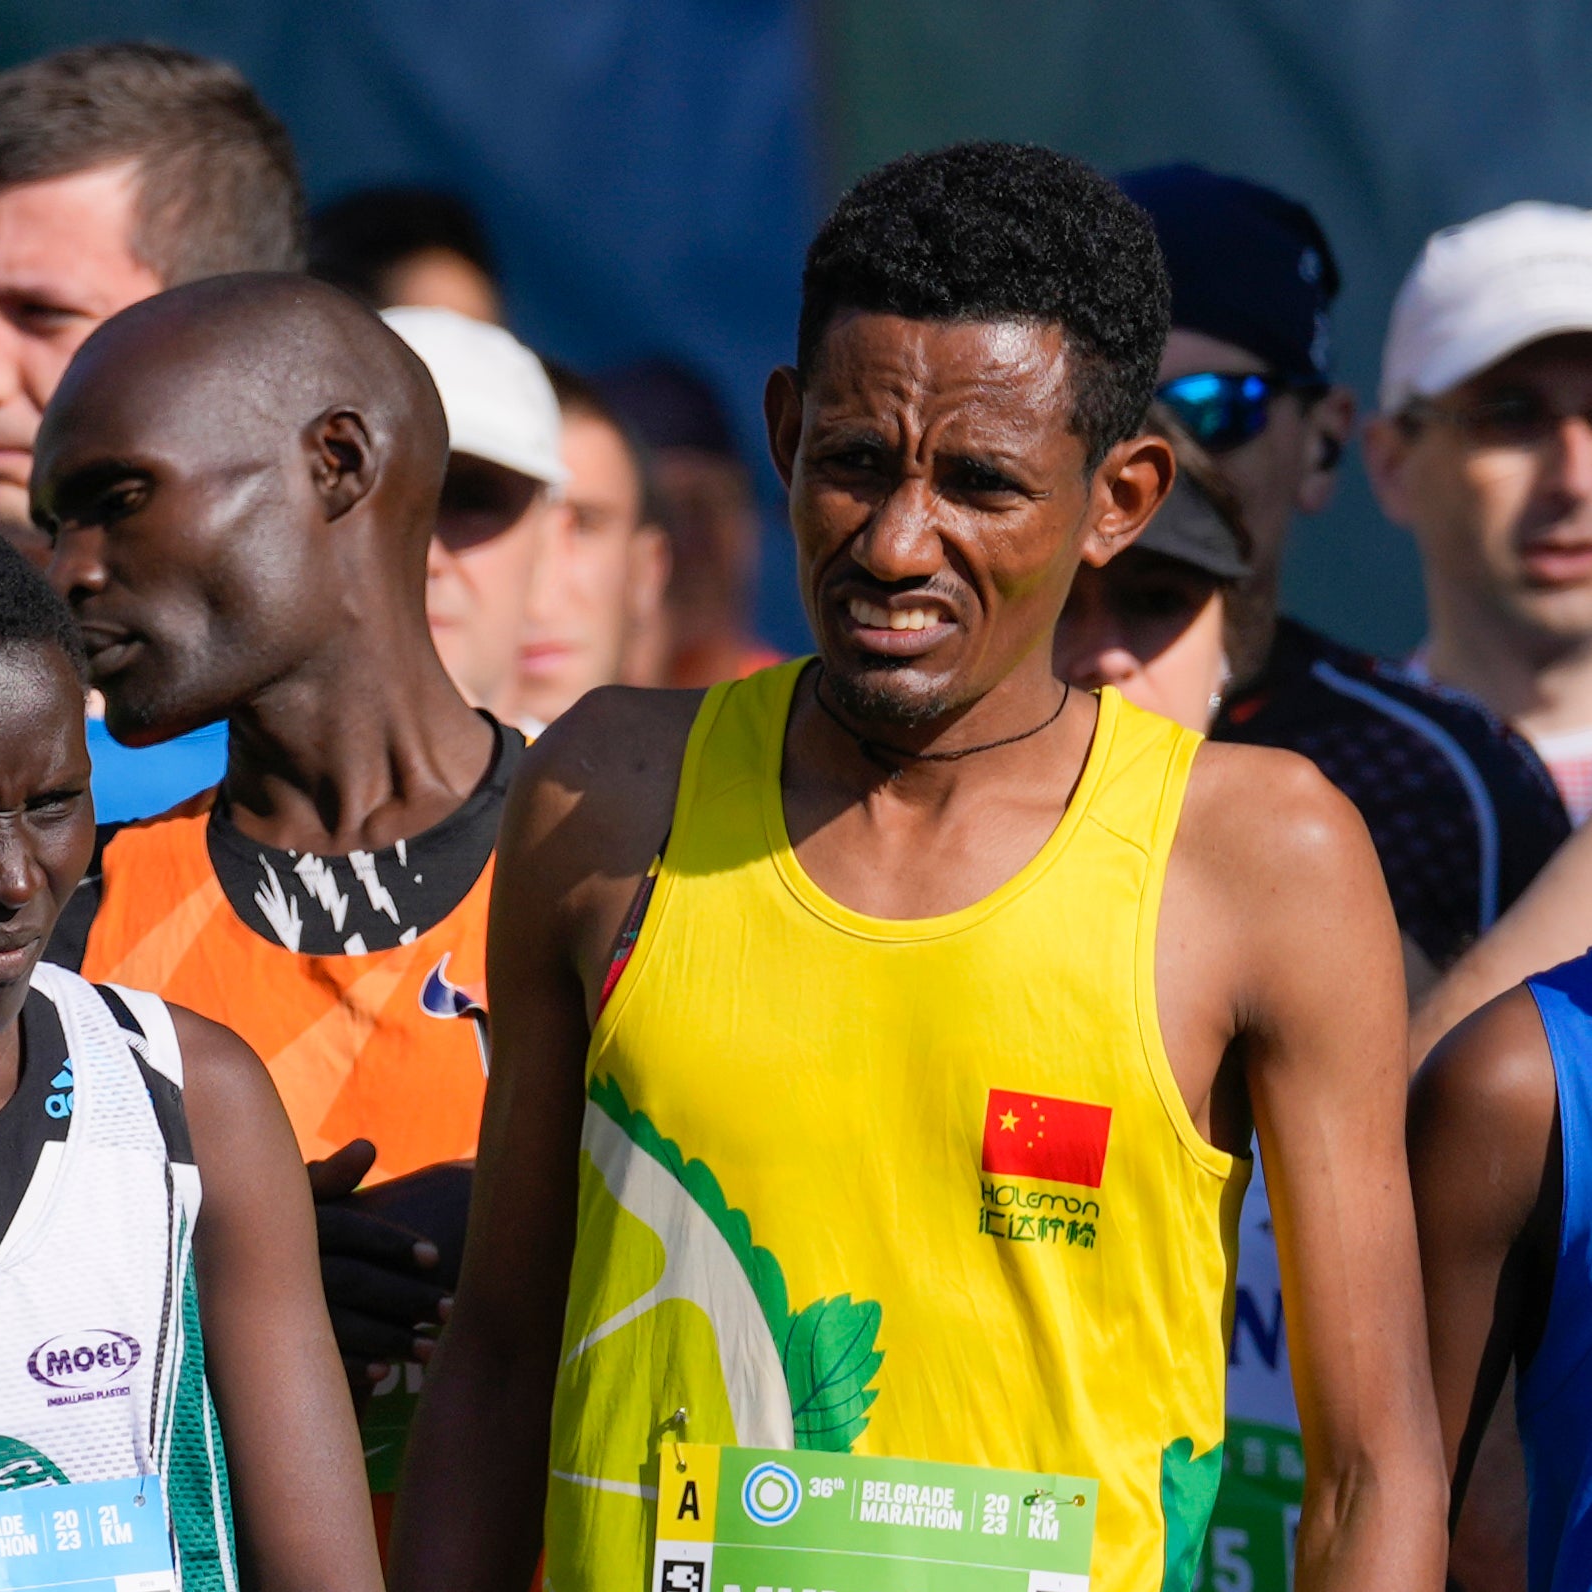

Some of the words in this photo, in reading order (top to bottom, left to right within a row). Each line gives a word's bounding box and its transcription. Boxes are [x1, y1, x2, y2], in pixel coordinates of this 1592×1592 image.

[46, 1341, 127, 1377] MOEL
[676, 1480, 700, 1521] A
[808, 1477, 845, 1498] 36th
[862, 1480, 955, 1509] BELGRADE
[983, 1493, 1010, 1515] 20
[1030, 1499, 1057, 1519] 42
[53, 1509, 79, 1530] 20
[98, 1505, 119, 1526] 21
[56, 1529, 82, 1550] 23
[101, 1522, 133, 1546] KM
[859, 1501, 963, 1531] MARATHON
[981, 1514, 1007, 1535] 23
[1028, 1517, 1059, 1541] KM
